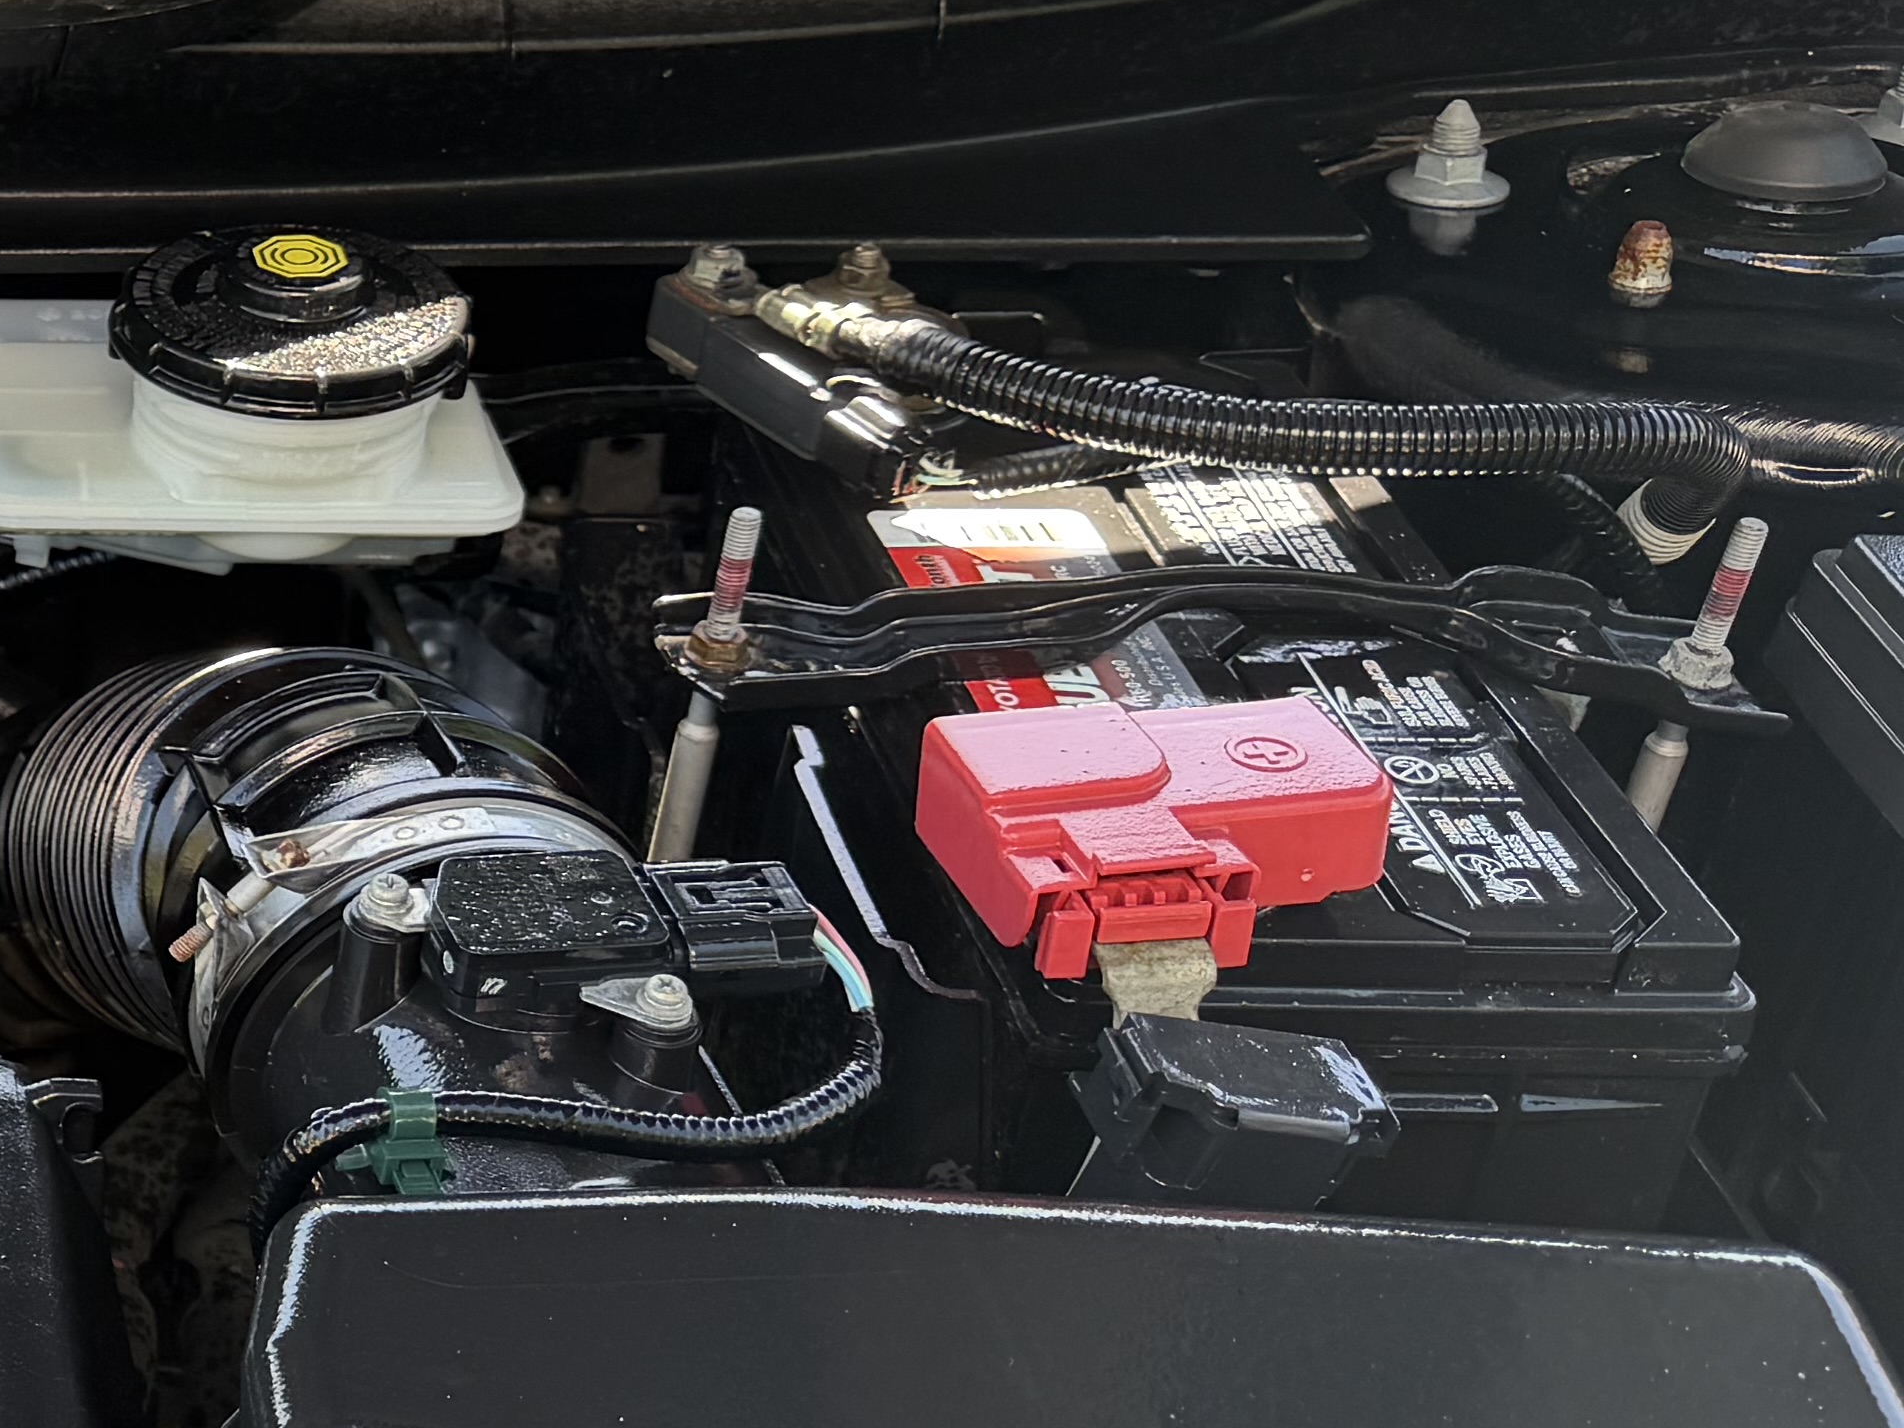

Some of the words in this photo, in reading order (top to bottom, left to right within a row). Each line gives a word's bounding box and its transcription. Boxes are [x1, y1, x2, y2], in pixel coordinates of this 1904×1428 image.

[1454, 817, 1486, 846] EYES
[1468, 813, 1523, 870] EXPLOSIVE
[1503, 833, 1541, 870] GASES
